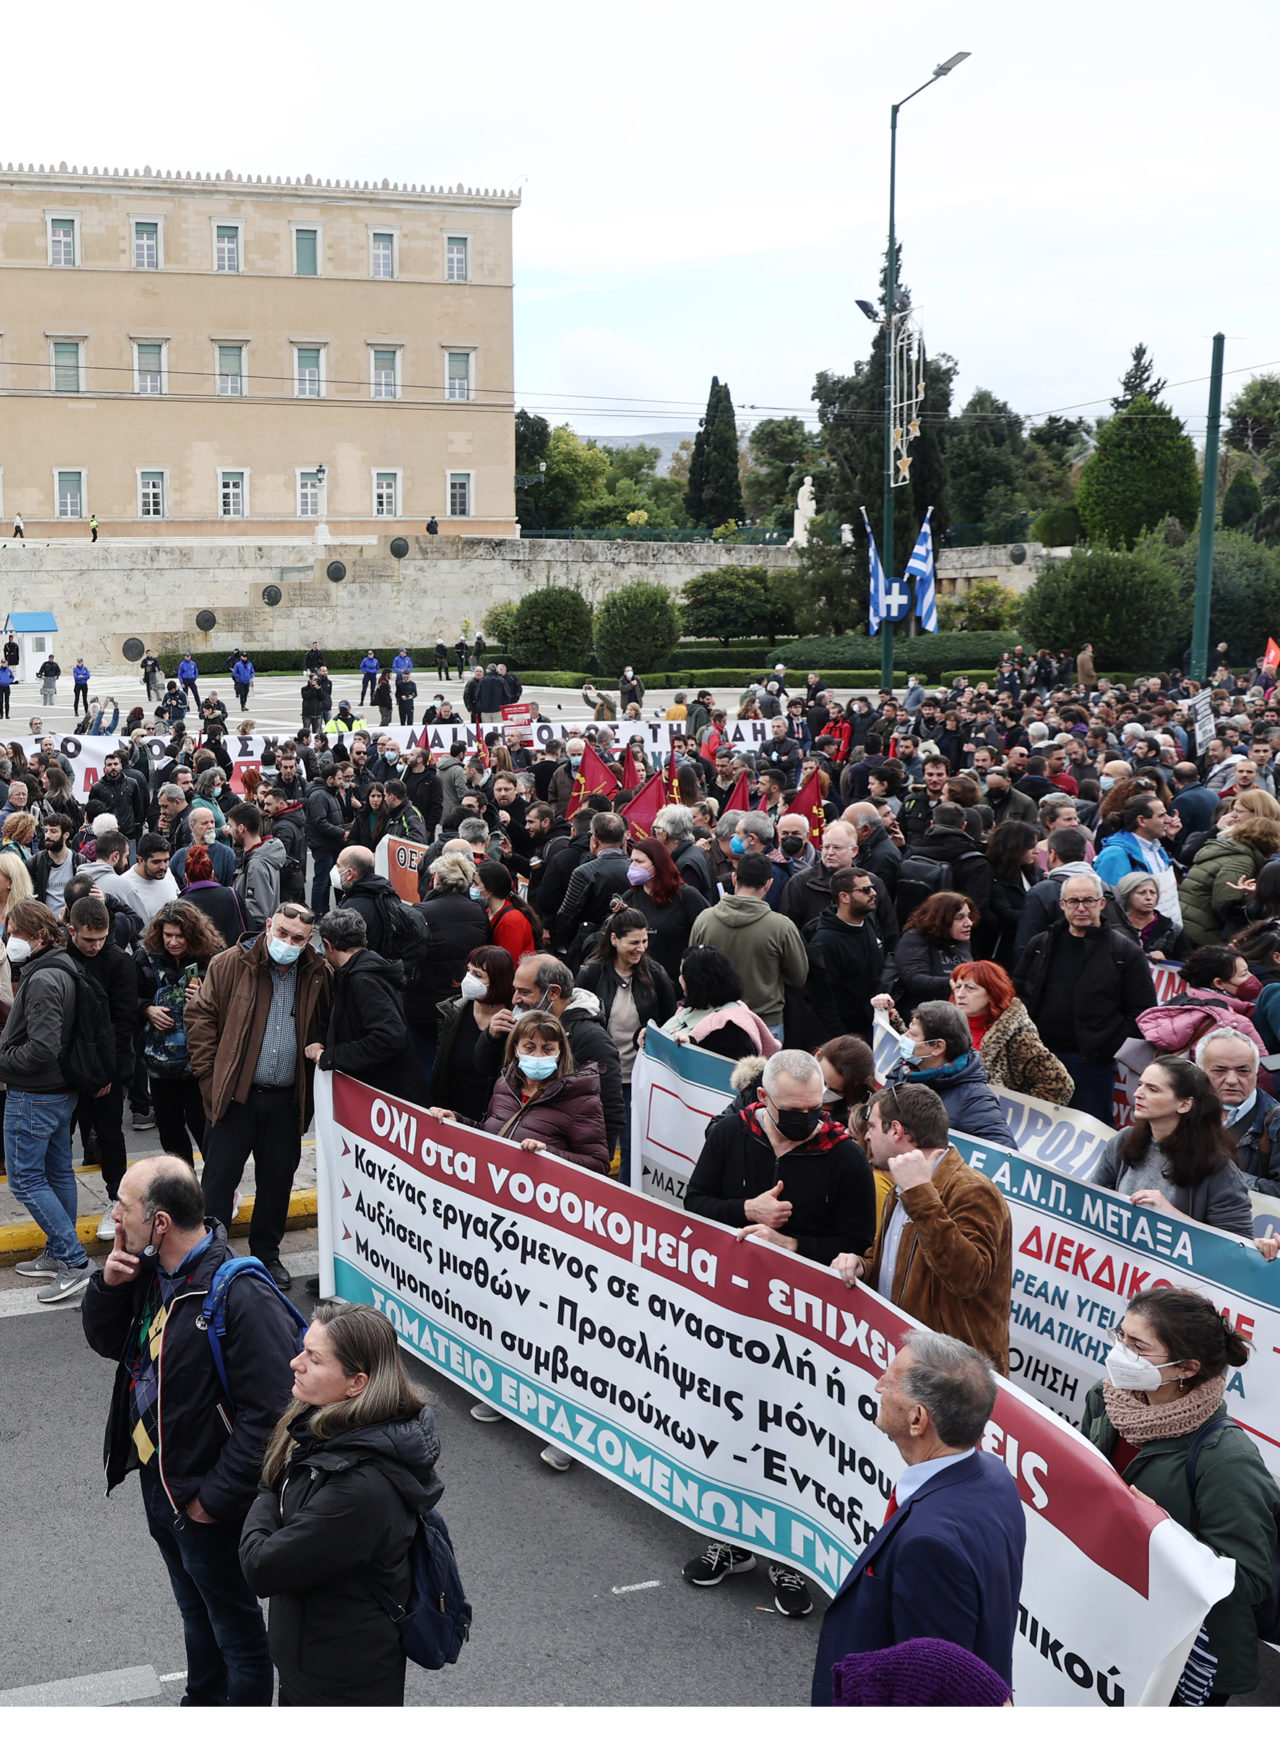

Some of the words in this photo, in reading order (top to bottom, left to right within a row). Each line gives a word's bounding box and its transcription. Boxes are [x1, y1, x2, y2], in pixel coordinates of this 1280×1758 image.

[370, 1098, 418, 1155] ΟΧΙ
[421, 1137, 477, 1184] στα
[487, 1162, 719, 1289] νοσοκομεία
[651, 1168, 686, 1200] ΜΑΖ
[1080, 1193, 1194, 1267] ΜΕΤΑΞΑ
[354, 1143, 428, 1216] Κανένας
[432, 1196, 599, 1293] εργαζόμενος
[607, 1275, 639, 1307] σε
[648, 1293, 816, 1386] αναστολή
[826, 1366, 846, 1406] ή
[858, 1393, 880, 1426] α
[354, 1190, 433, 1265] Αυξήσεις
[439, 1248, 531, 1306] μισθών
[557, 1295, 744, 1421] Προσλήψεις
[355, 1230, 493, 1341] Μονιμοποίηση
[500, 1330, 720, 1459] συμβασιούχων
[1010, 1300, 1114, 1367] ΗΜΑΤΙΚΗΣ
[1011, 1268, 1071, 1311] ΡΕΑΝ
[371, 1287, 494, 1393] ΣΩΜΑΤΕΙΟ
[501, 1372, 776, 1546] ΕΡΓΑΖΟΜΕΝΩΝ
[790, 1519, 852, 1588] ΓΝ
[1009, 1347, 1079, 1402] ΟΙΗΣΗ
